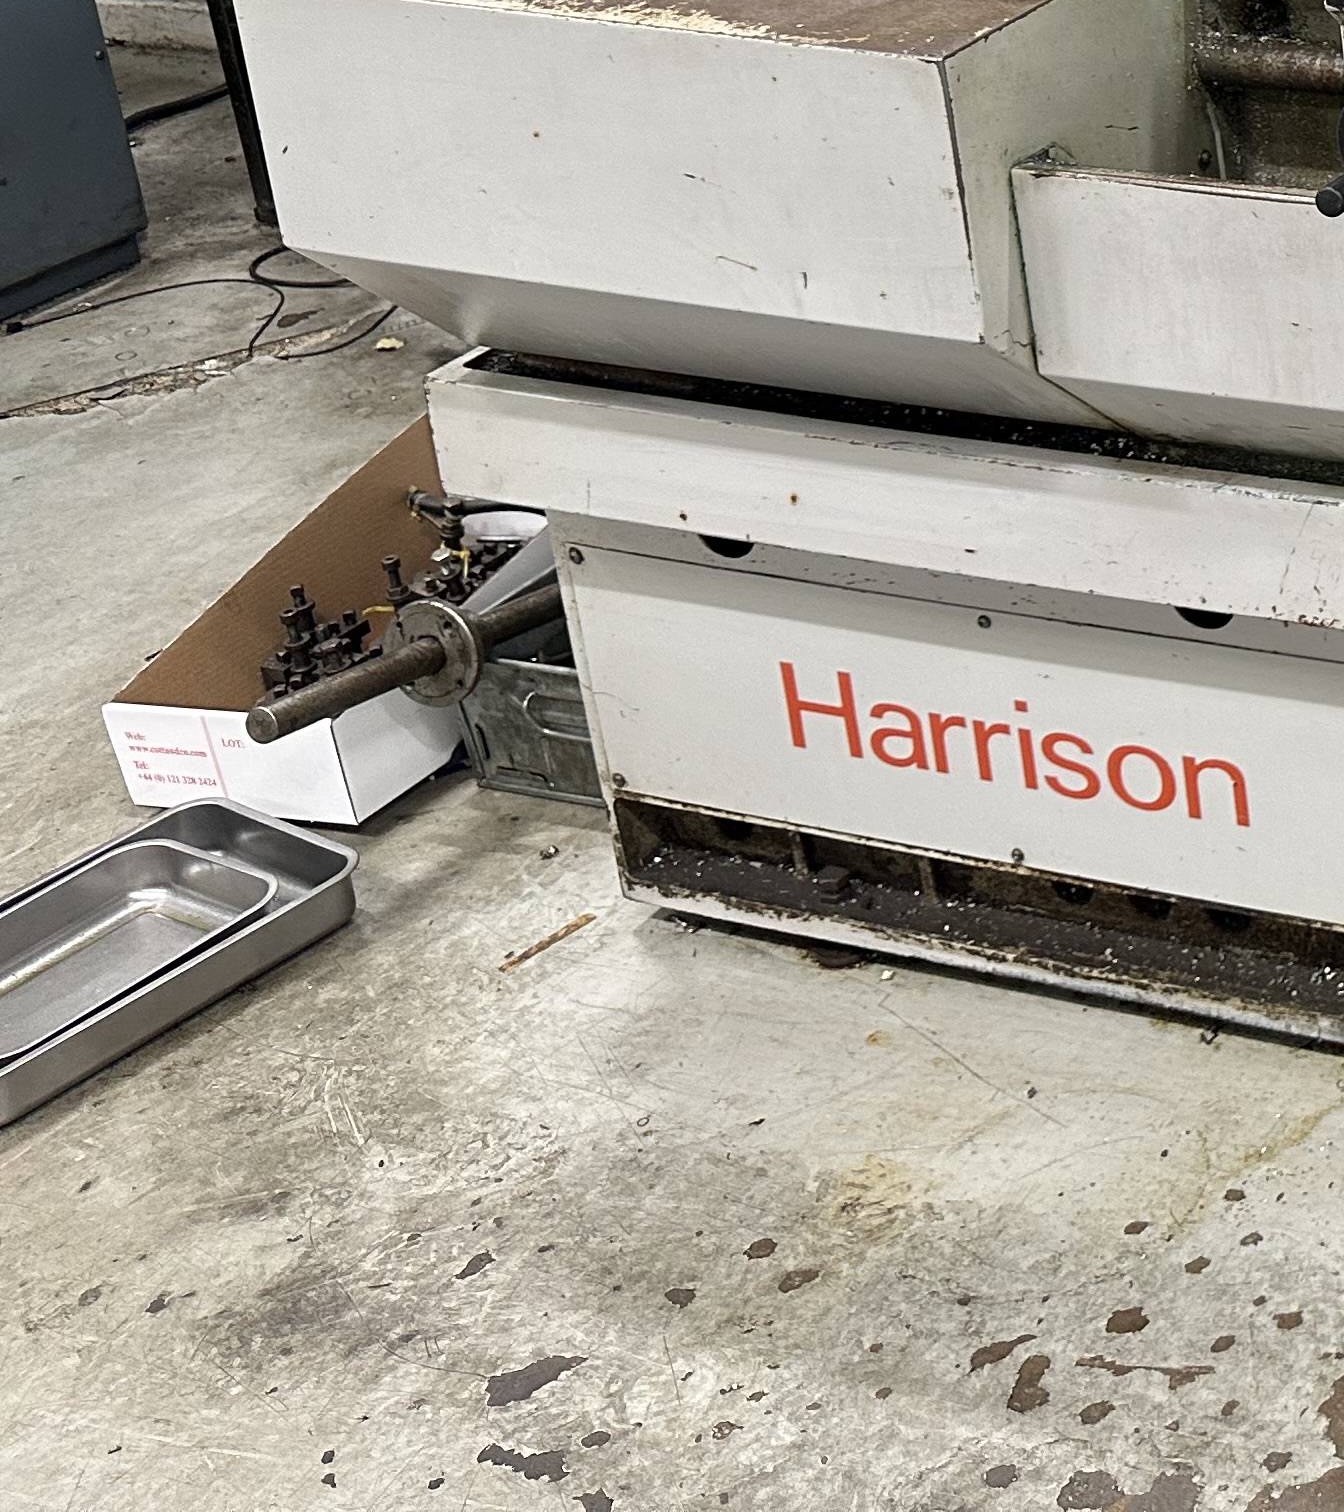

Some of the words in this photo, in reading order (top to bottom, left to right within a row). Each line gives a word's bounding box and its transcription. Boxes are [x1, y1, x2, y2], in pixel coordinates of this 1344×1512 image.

[124, 731, 146, 740] Web:
[221, 738, 245, 749] LOT:
[779, 661, 1250, 828] Harrison
[133, 760, 150, 769] Tel:
[167, 775, 180, 784] 121
